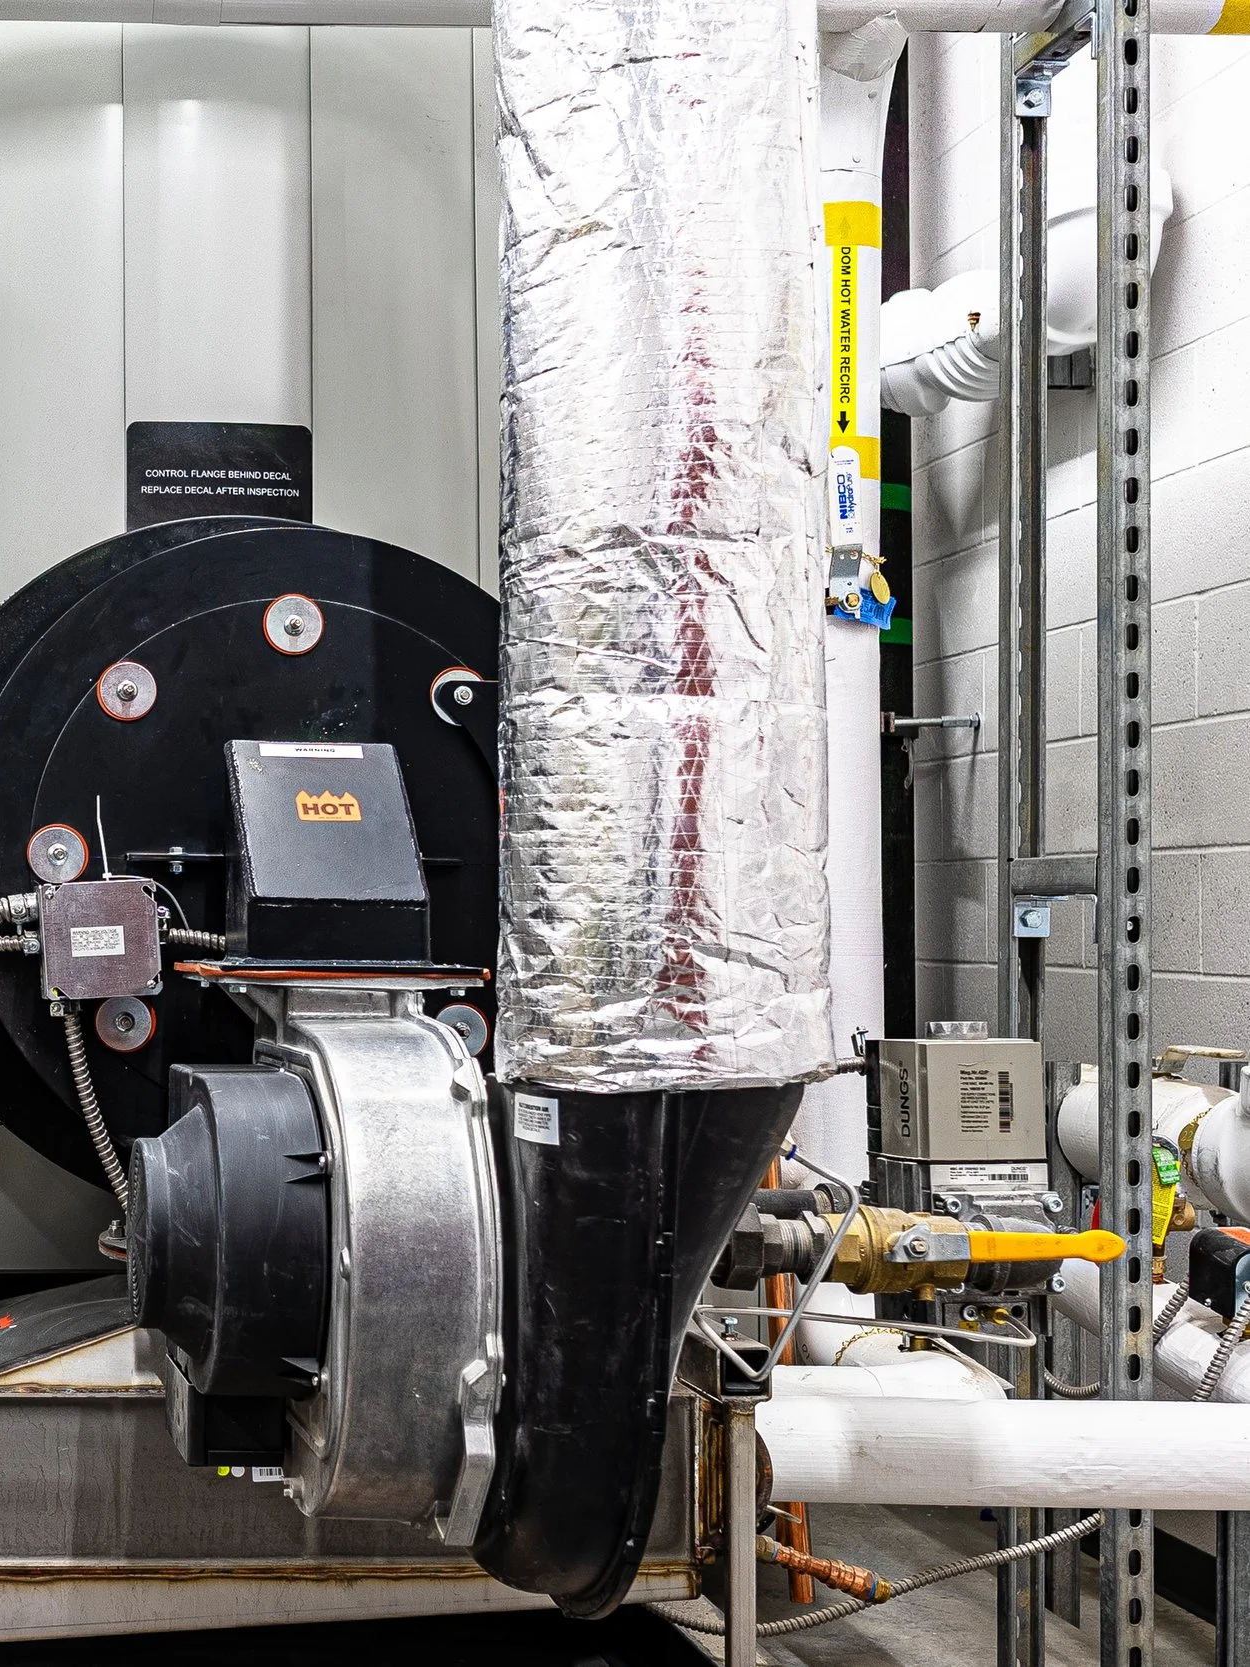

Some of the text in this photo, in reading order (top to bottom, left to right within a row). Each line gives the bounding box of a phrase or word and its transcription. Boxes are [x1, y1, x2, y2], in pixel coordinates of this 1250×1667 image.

[839, 247, 851, 404] DOM HOT WATER RECIRC
[145, 469, 292, 481] CONTROL FLANGE BEHIND DECAL
[141, 485, 299, 497] REPLACE DECAL AFTER INSPECTION
[837, 473, 848, 520] NIBCO
[301, 803, 354, 816] HOT
[899, 1068, 911, 1138] DUNGS
